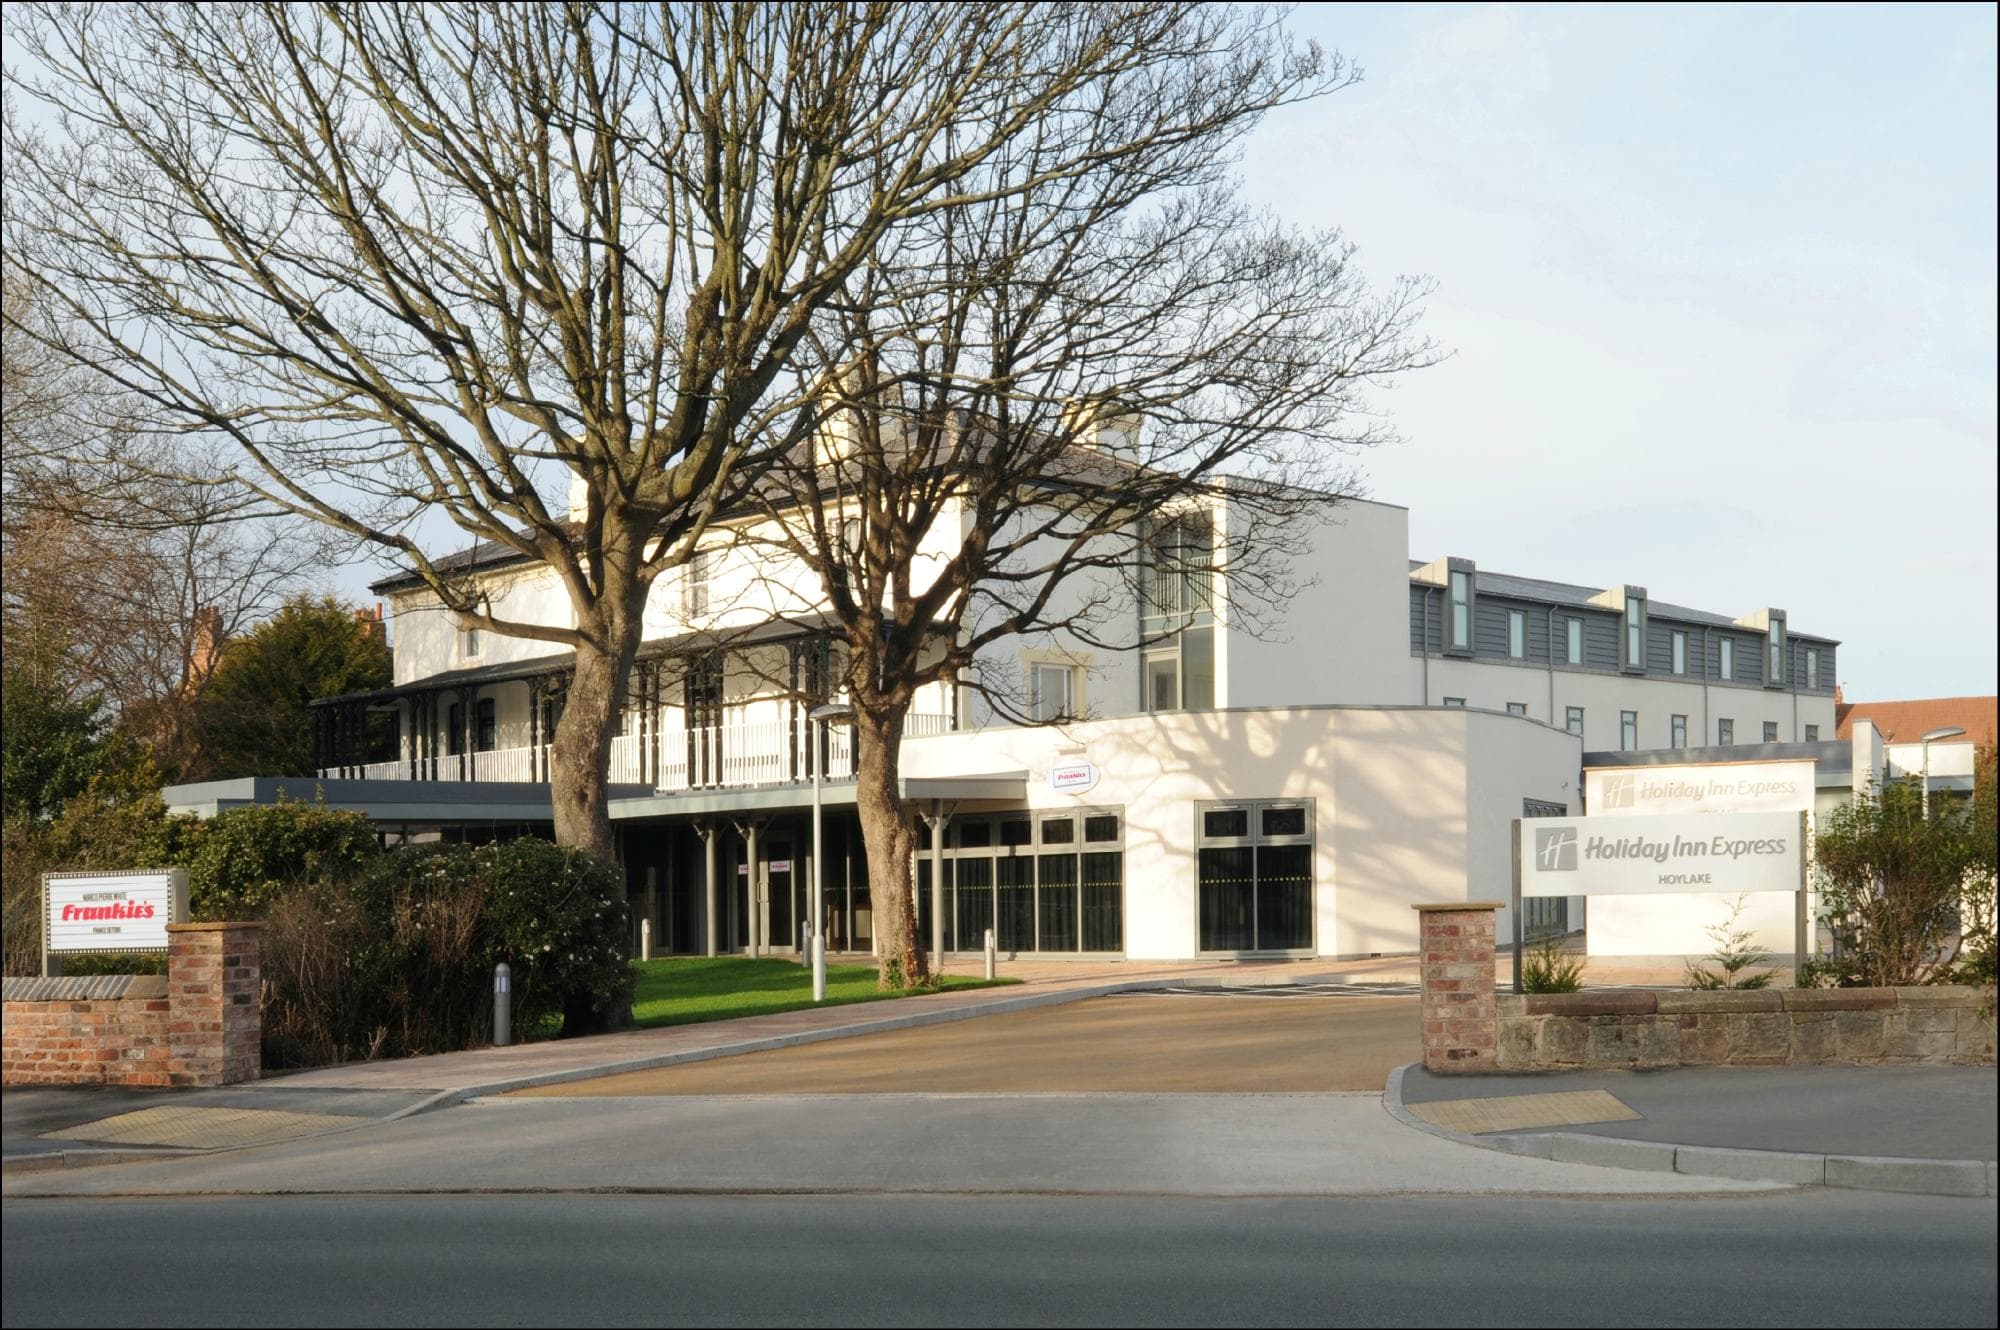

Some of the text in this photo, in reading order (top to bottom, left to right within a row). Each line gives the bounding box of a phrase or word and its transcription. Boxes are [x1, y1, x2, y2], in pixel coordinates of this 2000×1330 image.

[1640, 779, 1797, 801] Holiday Inn Express
[1585, 835, 1786, 863] Holiday Inn Express
[1658, 873, 1712, 885] HOYLAKE
[62, 899, 155, 921] Frankie's
